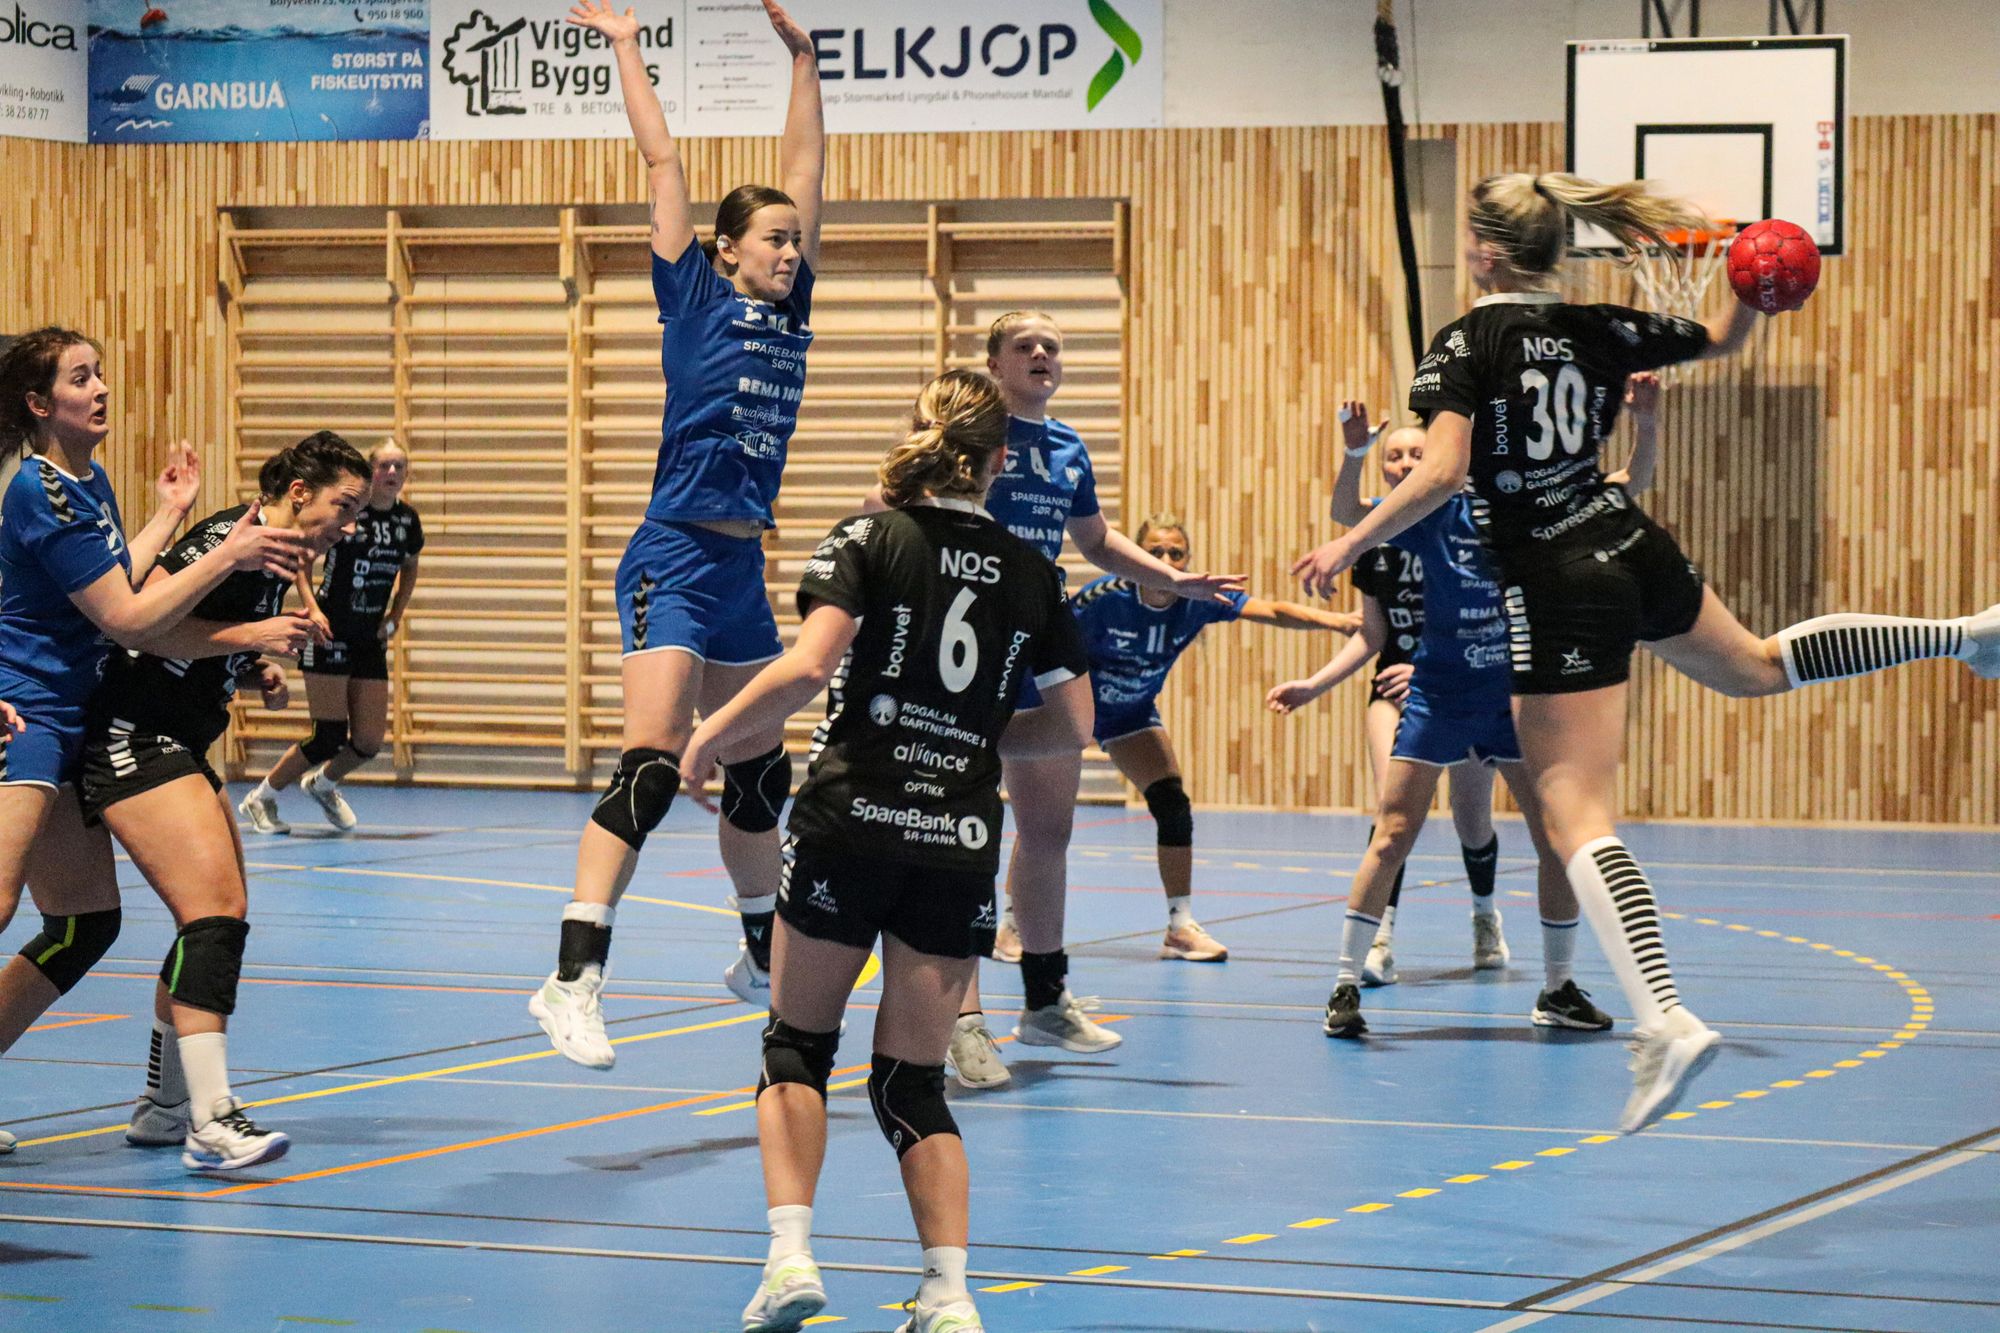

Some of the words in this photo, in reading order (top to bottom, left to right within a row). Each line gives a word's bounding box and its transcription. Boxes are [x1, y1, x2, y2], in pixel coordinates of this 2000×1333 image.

[367, 10, 387, 20] 950
[391, 10, 400, 19] 18
[531, 18, 674, 57] Vigend
[332, 52, 397, 68] STØRST
[402, 48, 423, 67] PÅ
[311, 74, 423, 90] FISKEUTSTYR
[532, 60, 611, 95] Bygg
[30, 87, 65, 103] Robotikk
[155, 81, 285, 111] GARNBUA
[844, 91, 904, 103] Stormarked
[907, 89, 950, 103] Lyngdal
[952, 91, 960, 101] &
[963, 88, 1029, 101] Phonehouse
[1033, 87, 1073, 99] Mandal
[533, 103, 555, 114] TRE
[564, 103, 572, 114] &
[1522, 337, 1575, 362] NOS
[771, 358, 795, 372] SØR
[738, 377, 780, 399] REMA
[1520, 363, 1587, 461] 30
[1490, 396, 1508, 456] bouvet
[1032, 505, 1051, 514] SØR
[372, 520, 391, 545] 35
[940, 547, 1001, 584] NOS
[1399, 550, 1424, 582] 26
[1460, 608, 1499, 619] REMA
[881, 604, 912, 678] bouvet
[939, 586, 978, 693] 6
[1146, 625, 1166, 654] 11
[997, 630, 1031, 699] bouvet
[904, 781, 945, 798] OPTIKK
[851, 797, 956, 832] SpareBank
[903, 829, 957, 845] SR-BANK
